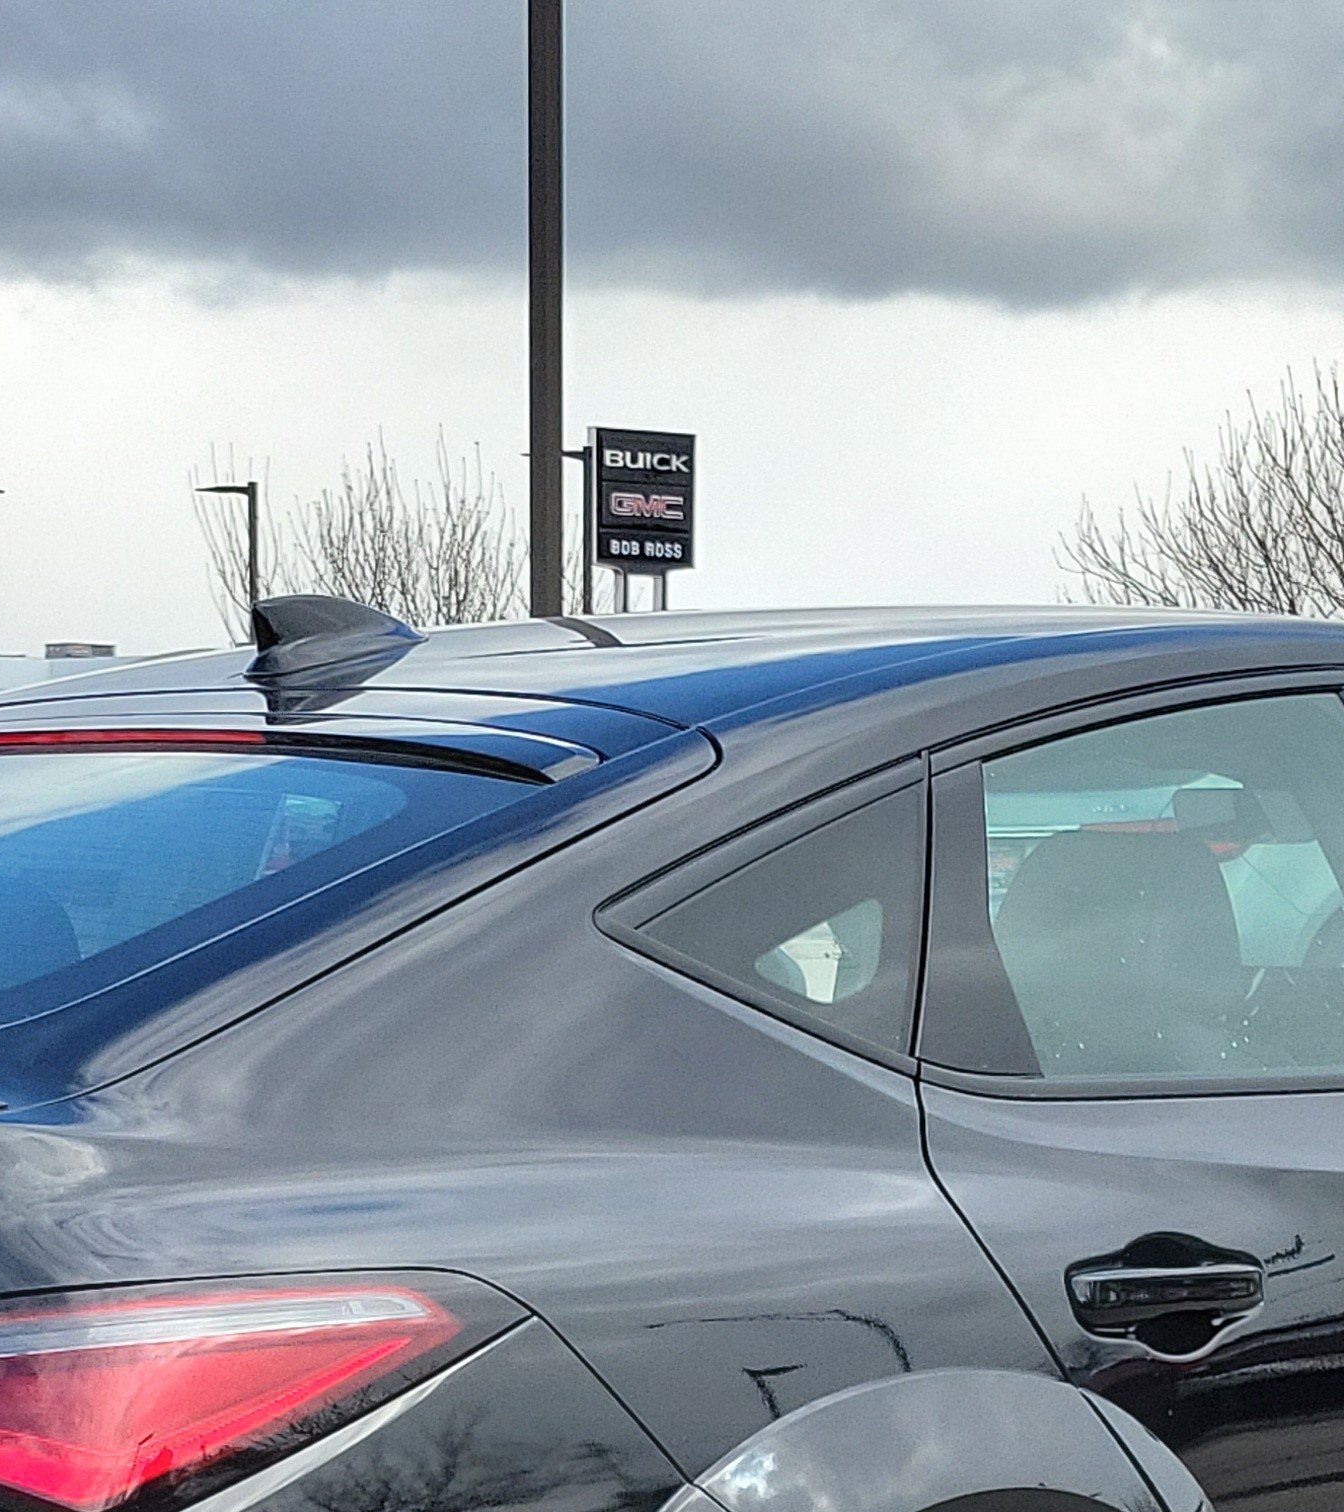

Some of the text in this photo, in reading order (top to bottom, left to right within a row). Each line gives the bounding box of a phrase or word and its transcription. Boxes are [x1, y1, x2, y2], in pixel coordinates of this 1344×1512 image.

[603, 449, 690, 473] BUICK
[611, 492, 684, 520] GMC
[610, 539, 683, 559] BOB ROSS
